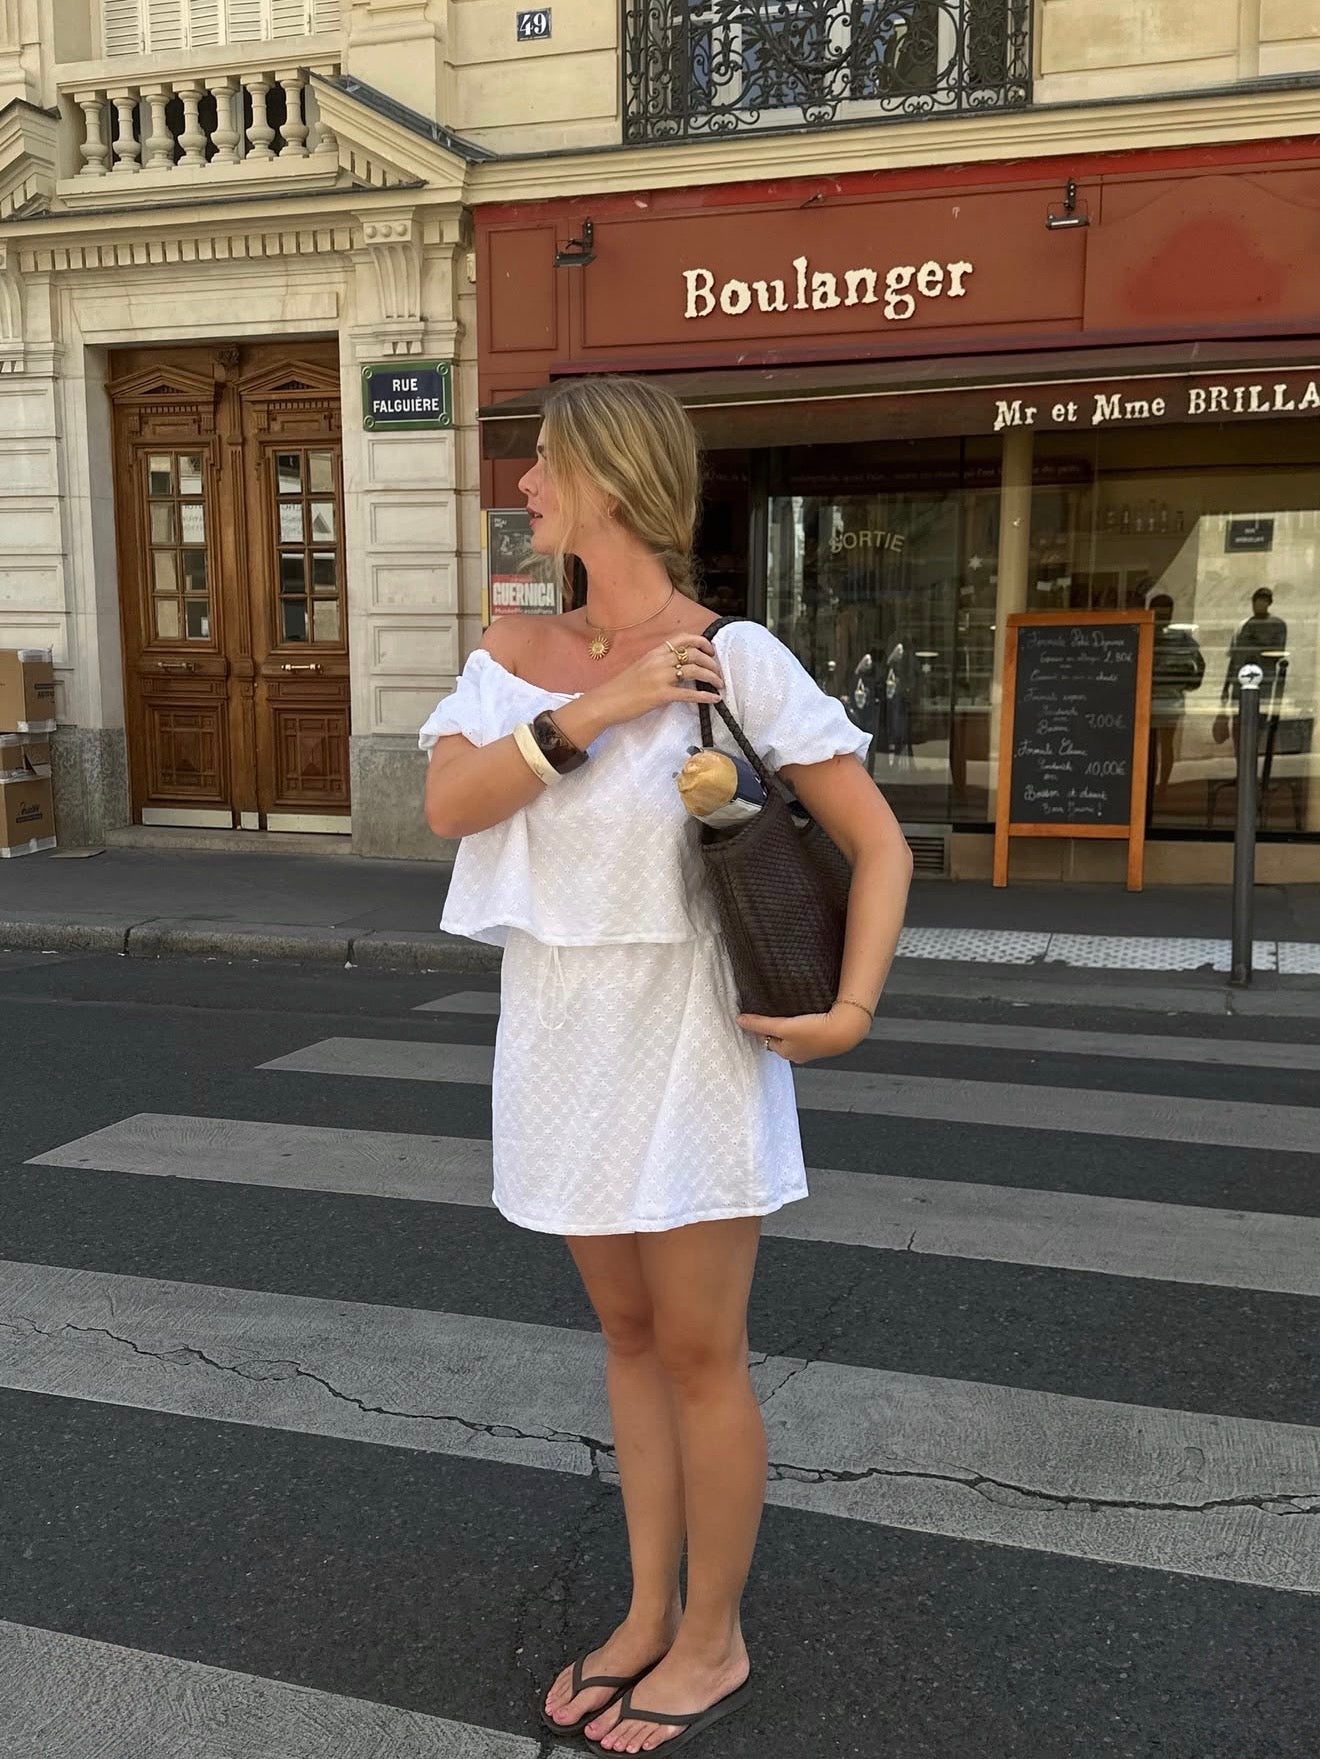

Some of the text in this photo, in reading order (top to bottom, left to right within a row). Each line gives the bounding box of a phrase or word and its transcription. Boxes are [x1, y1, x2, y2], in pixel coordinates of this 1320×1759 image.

[520, 13, 547, 36] 49
[682, 256, 973, 320] Boulanger
[392, 378, 418, 392] RUE
[373, 396, 440, 413] FALGUIÈRE
[993, 381, 1320, 431] Mr et Mme BRILLA
[492, 582, 555, 607] GUERNICA
[1084, 760, 1127, 778] 10,00€
